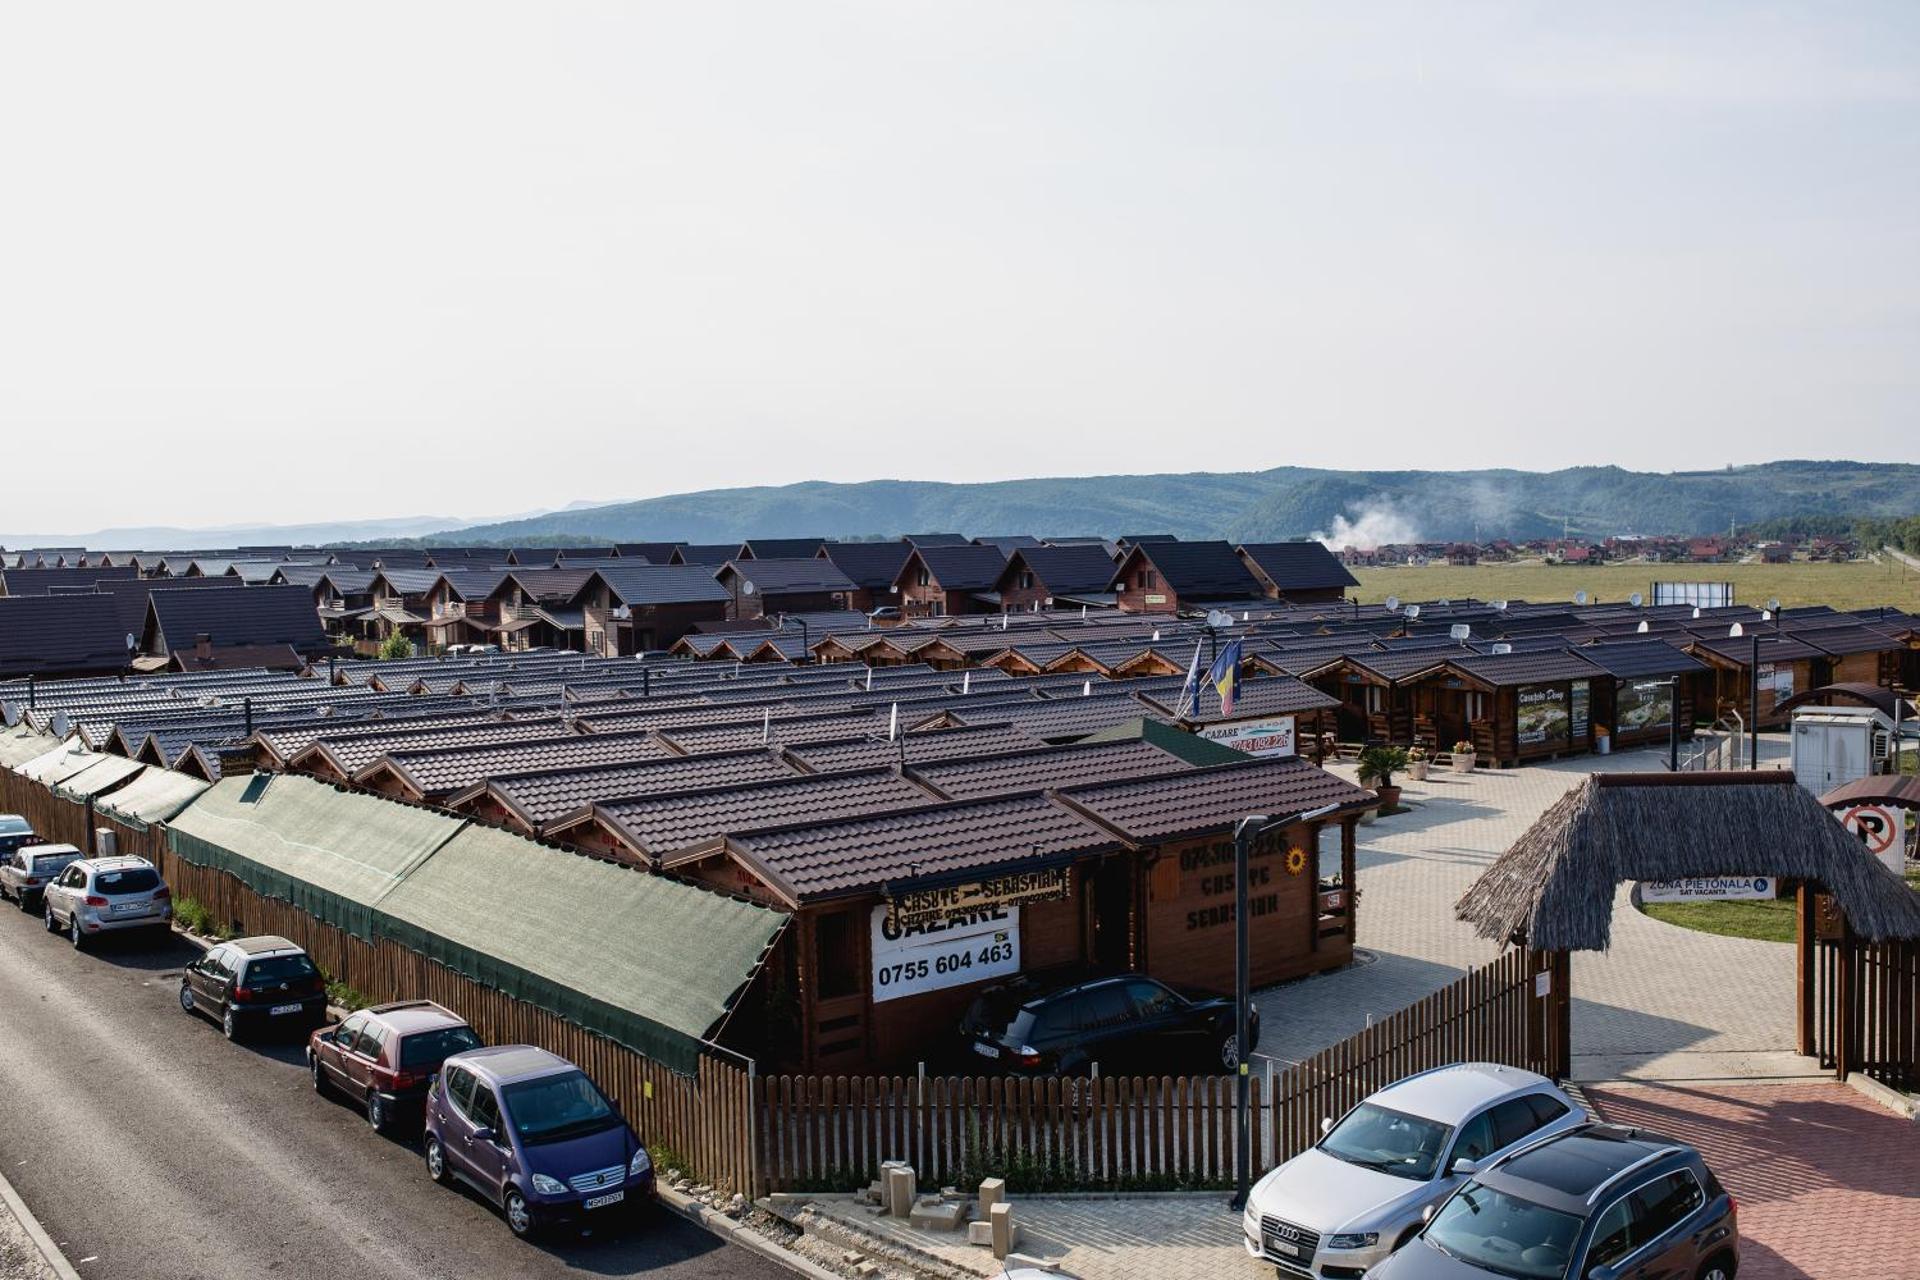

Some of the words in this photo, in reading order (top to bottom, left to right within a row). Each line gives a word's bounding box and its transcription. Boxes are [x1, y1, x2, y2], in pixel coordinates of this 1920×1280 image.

[1205, 728, 1239, 740] CAZARE
[1650, 880, 1683, 890] ZONA
[879, 959, 928, 985] 0755
[935, 951, 972, 974] 604
[978, 943, 1013, 965] 463
